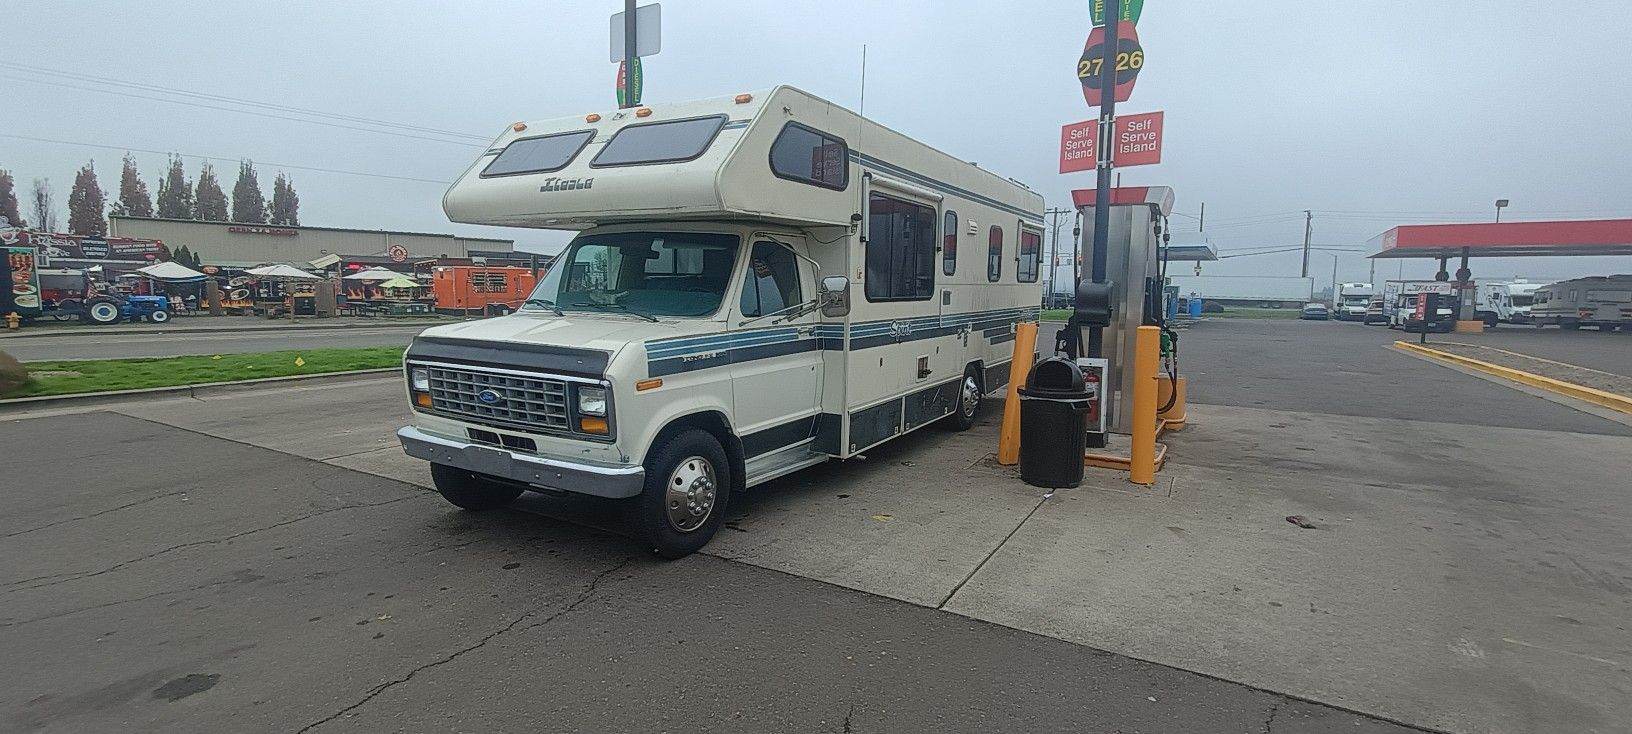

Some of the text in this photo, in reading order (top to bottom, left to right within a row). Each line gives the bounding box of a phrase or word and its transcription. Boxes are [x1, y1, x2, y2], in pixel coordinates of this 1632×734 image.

[1115, 51, 1143, 71] 26
[1079, 58, 1104, 78] 27
[1128, 119, 1152, 131] Self
[1071, 127, 1090, 139] Self
[1121, 131, 1156, 143] Serve
[1066, 139, 1093, 150] Serve
[1120, 141, 1156, 154] Island
[1065, 149, 1093, 160] Island
